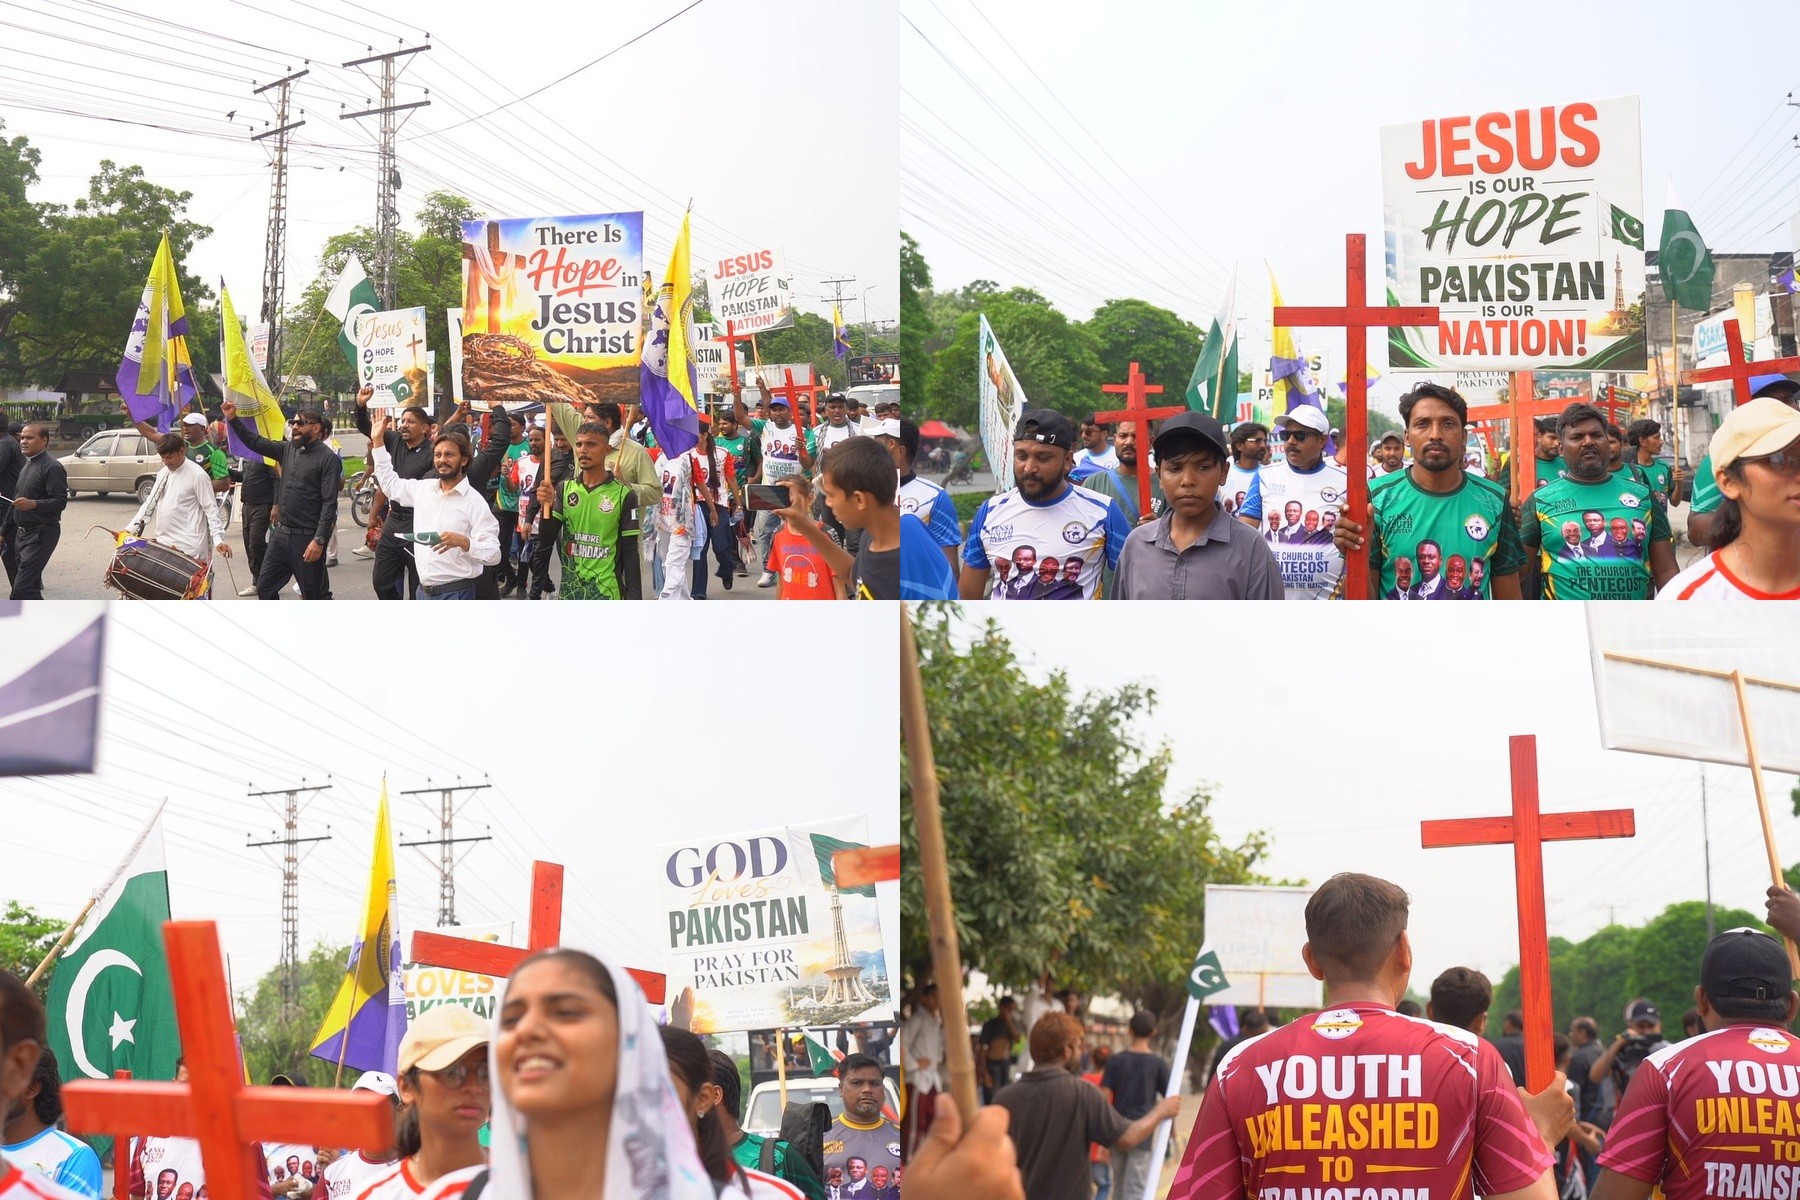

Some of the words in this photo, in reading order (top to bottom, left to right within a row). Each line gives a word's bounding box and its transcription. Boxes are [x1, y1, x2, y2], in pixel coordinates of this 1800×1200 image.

[1404, 102, 1601, 180] JESUS
[1469, 180, 1487, 195] IS
[1492, 177, 1535, 193] OUR
[535, 226, 598, 246] There
[603, 224, 622, 243] Is
[1421, 192, 1590, 255] HOPE
[526, 247, 622, 298] Hope
[622, 272, 638, 287] in
[714, 250, 773, 280] JESUS
[721, 275, 771, 300] HOPE
[1419, 261, 1605, 303] PAKISTAN
[531, 294, 637, 330] Jesus
[721, 295, 778, 317] PAKISTAN
[1482, 305, 1496, 317] IS
[1500, 305, 1534, 317] OUR
[363, 317, 403, 347] Jesus
[543, 328, 635, 354] Christ
[1438, 319, 1587, 357] NATION!
[375, 348, 395, 356] HOPE
[1457, 371, 1482, 379] PRAY
[1281, 551, 1313, 561] CHURCH
[1315, 551, 1324, 560] OF
[1594, 566, 1630, 576] CHURCH
[1569, 577, 1642, 592] PENTECOST
[666, 836, 788, 888] GOD
[689, 867, 770, 908] Loves
[668, 895, 809, 949] PAKISTAN
[693, 953, 746, 973] PRAY
[752, 948, 795, 966] FOR
[403, 971, 494, 997] LOVES
[694, 964, 800, 990] PAKISTAN
[1255, 1054, 1422, 1105] YOUTH
[1705, 1060, 1800, 1097] YOU
[1245, 1102, 1439, 1159] UNLEASHED
[1771, 1140, 1800, 1162] TO
[1318, 1156, 1354, 1183] TO
